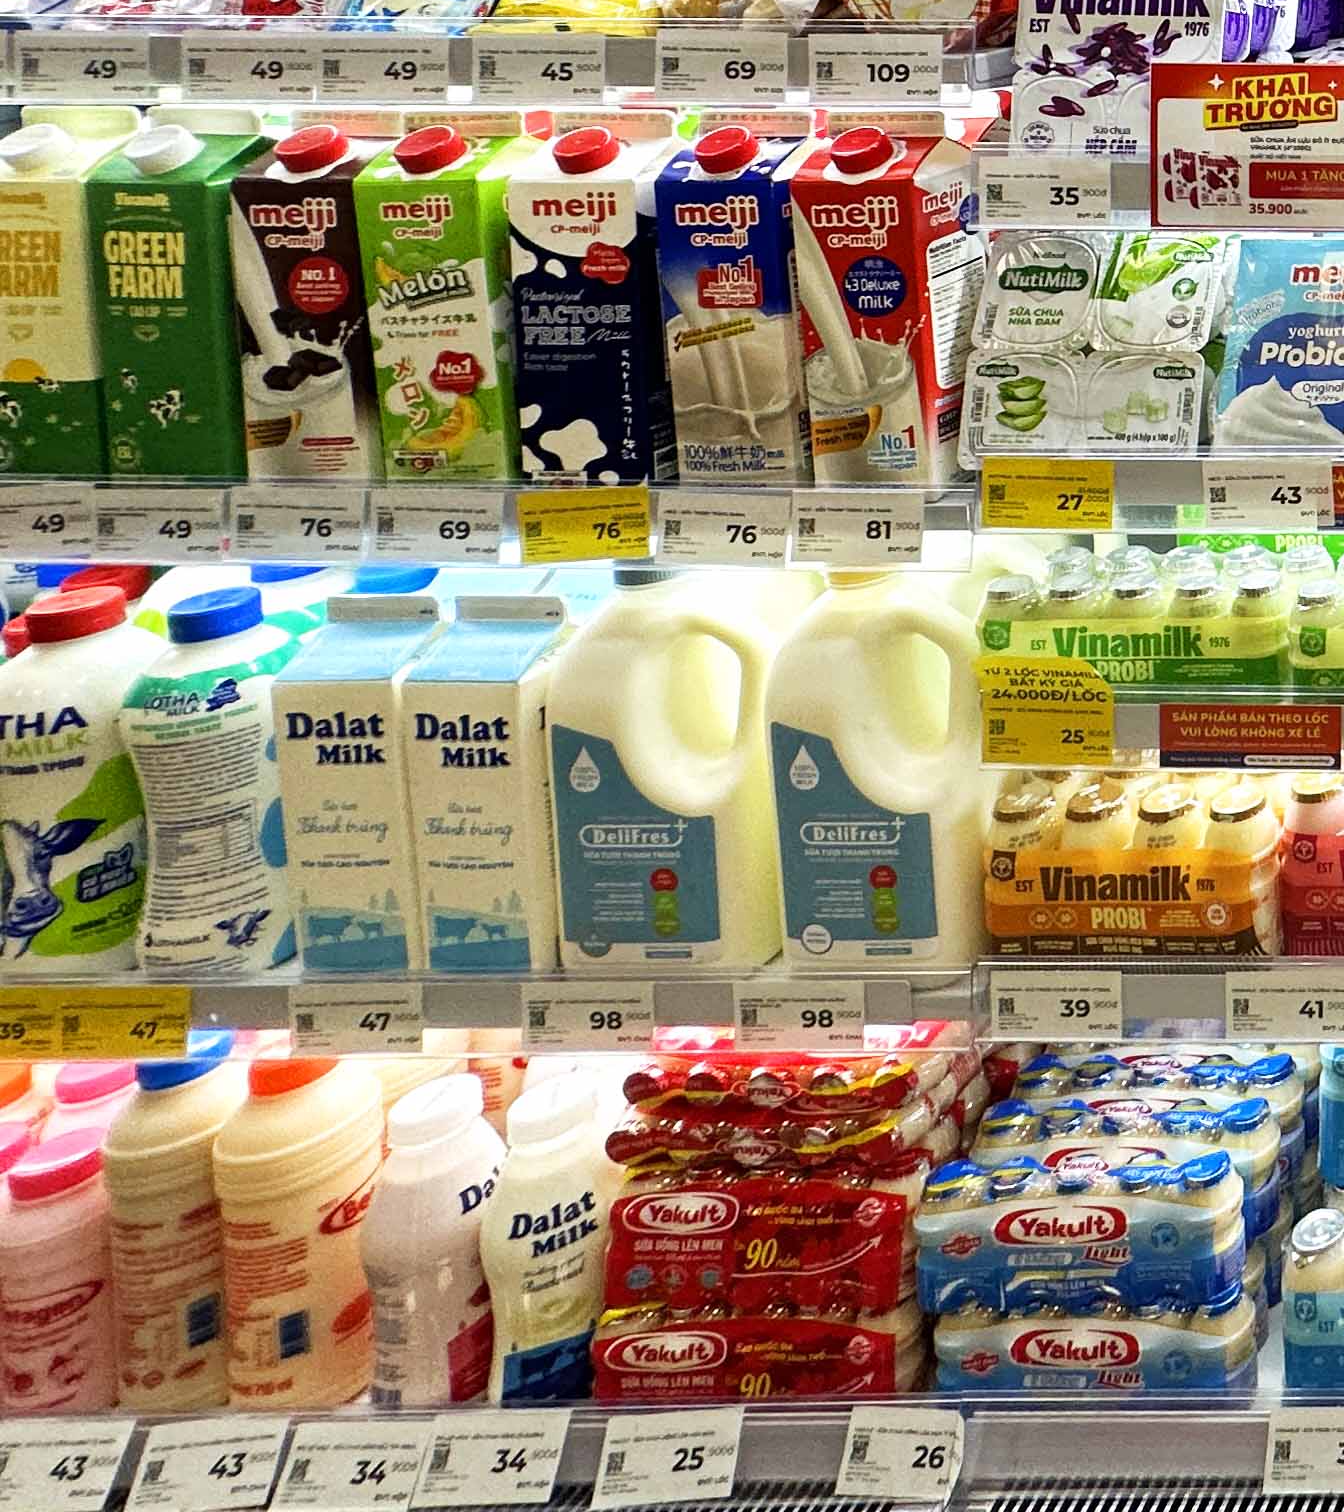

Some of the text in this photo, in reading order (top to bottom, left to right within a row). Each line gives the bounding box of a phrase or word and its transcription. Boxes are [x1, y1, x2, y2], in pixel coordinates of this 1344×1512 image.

[1233, 75, 1307, 98] KHAI
[1265, 170, 1297, 182] MUA
[249, 198, 338, 233] meiji
[380, 197, 453, 229] meiji
[532, 192, 617, 223] meiji
[676, 196, 759, 228] meiji
[811, 198, 899, 229] meiji
[550, 223, 601, 235] CP-meiji
[104, 231, 185, 265] GREEN
[108, 265, 184, 300] FARM
[1005, 268, 1084, 289] NutiMilk
[521, 304, 632, 325] LACTOSE
[522, 326, 586, 346] FREE
[286, 712, 384, 740] Dalat
[316, 744, 385, 766] Milk
[646, 1201, 723, 1227] Yakult
[1017, 1213, 1112, 1241] Yakult
[530, 1215, 599, 1260] Milk
[744, 1239, 776, 1269] 90
